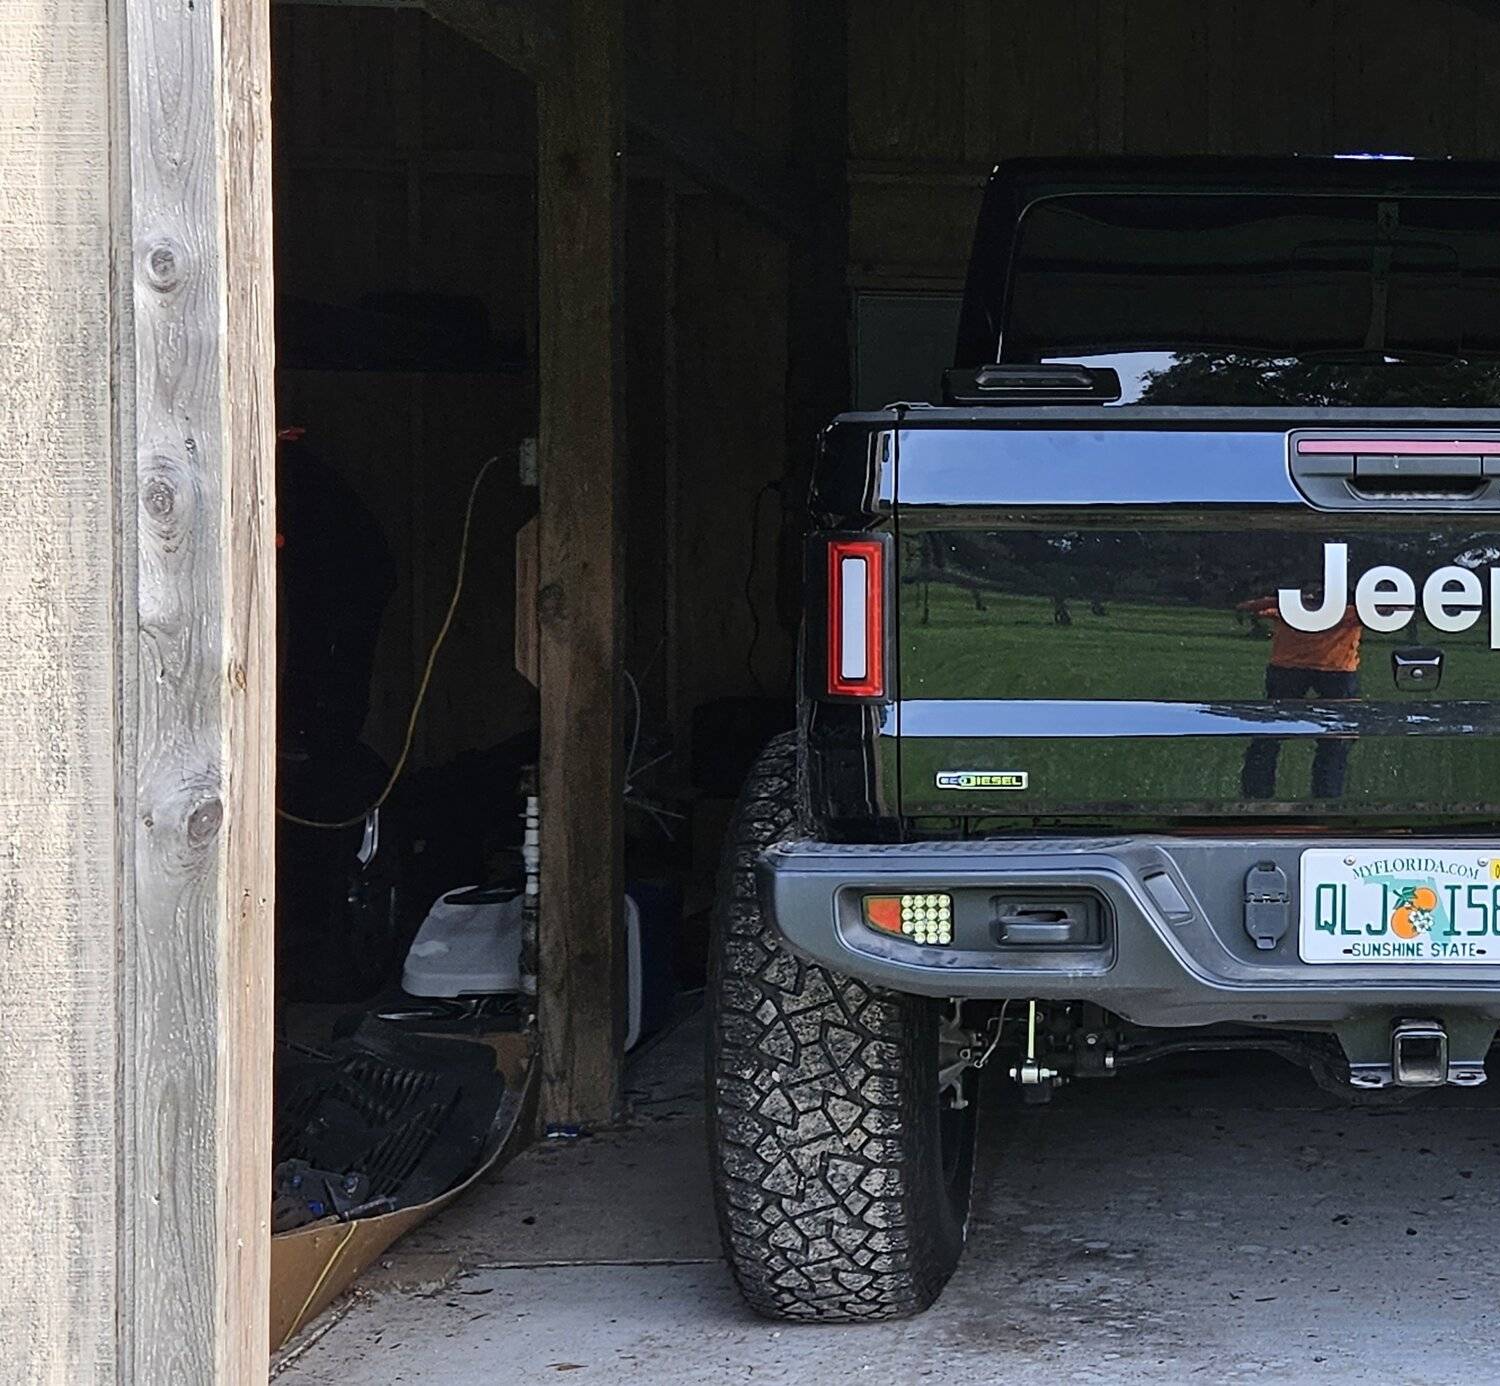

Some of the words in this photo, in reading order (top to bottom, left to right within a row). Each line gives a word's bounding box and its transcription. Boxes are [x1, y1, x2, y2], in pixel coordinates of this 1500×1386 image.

[1352, 858, 1480, 880] MYFLORIDA.COM
[1315, 883, 1388, 936] QLJ
[1352, 942, 1424, 957] SUNSHINE
[1431, 942, 1476, 957] STATE
